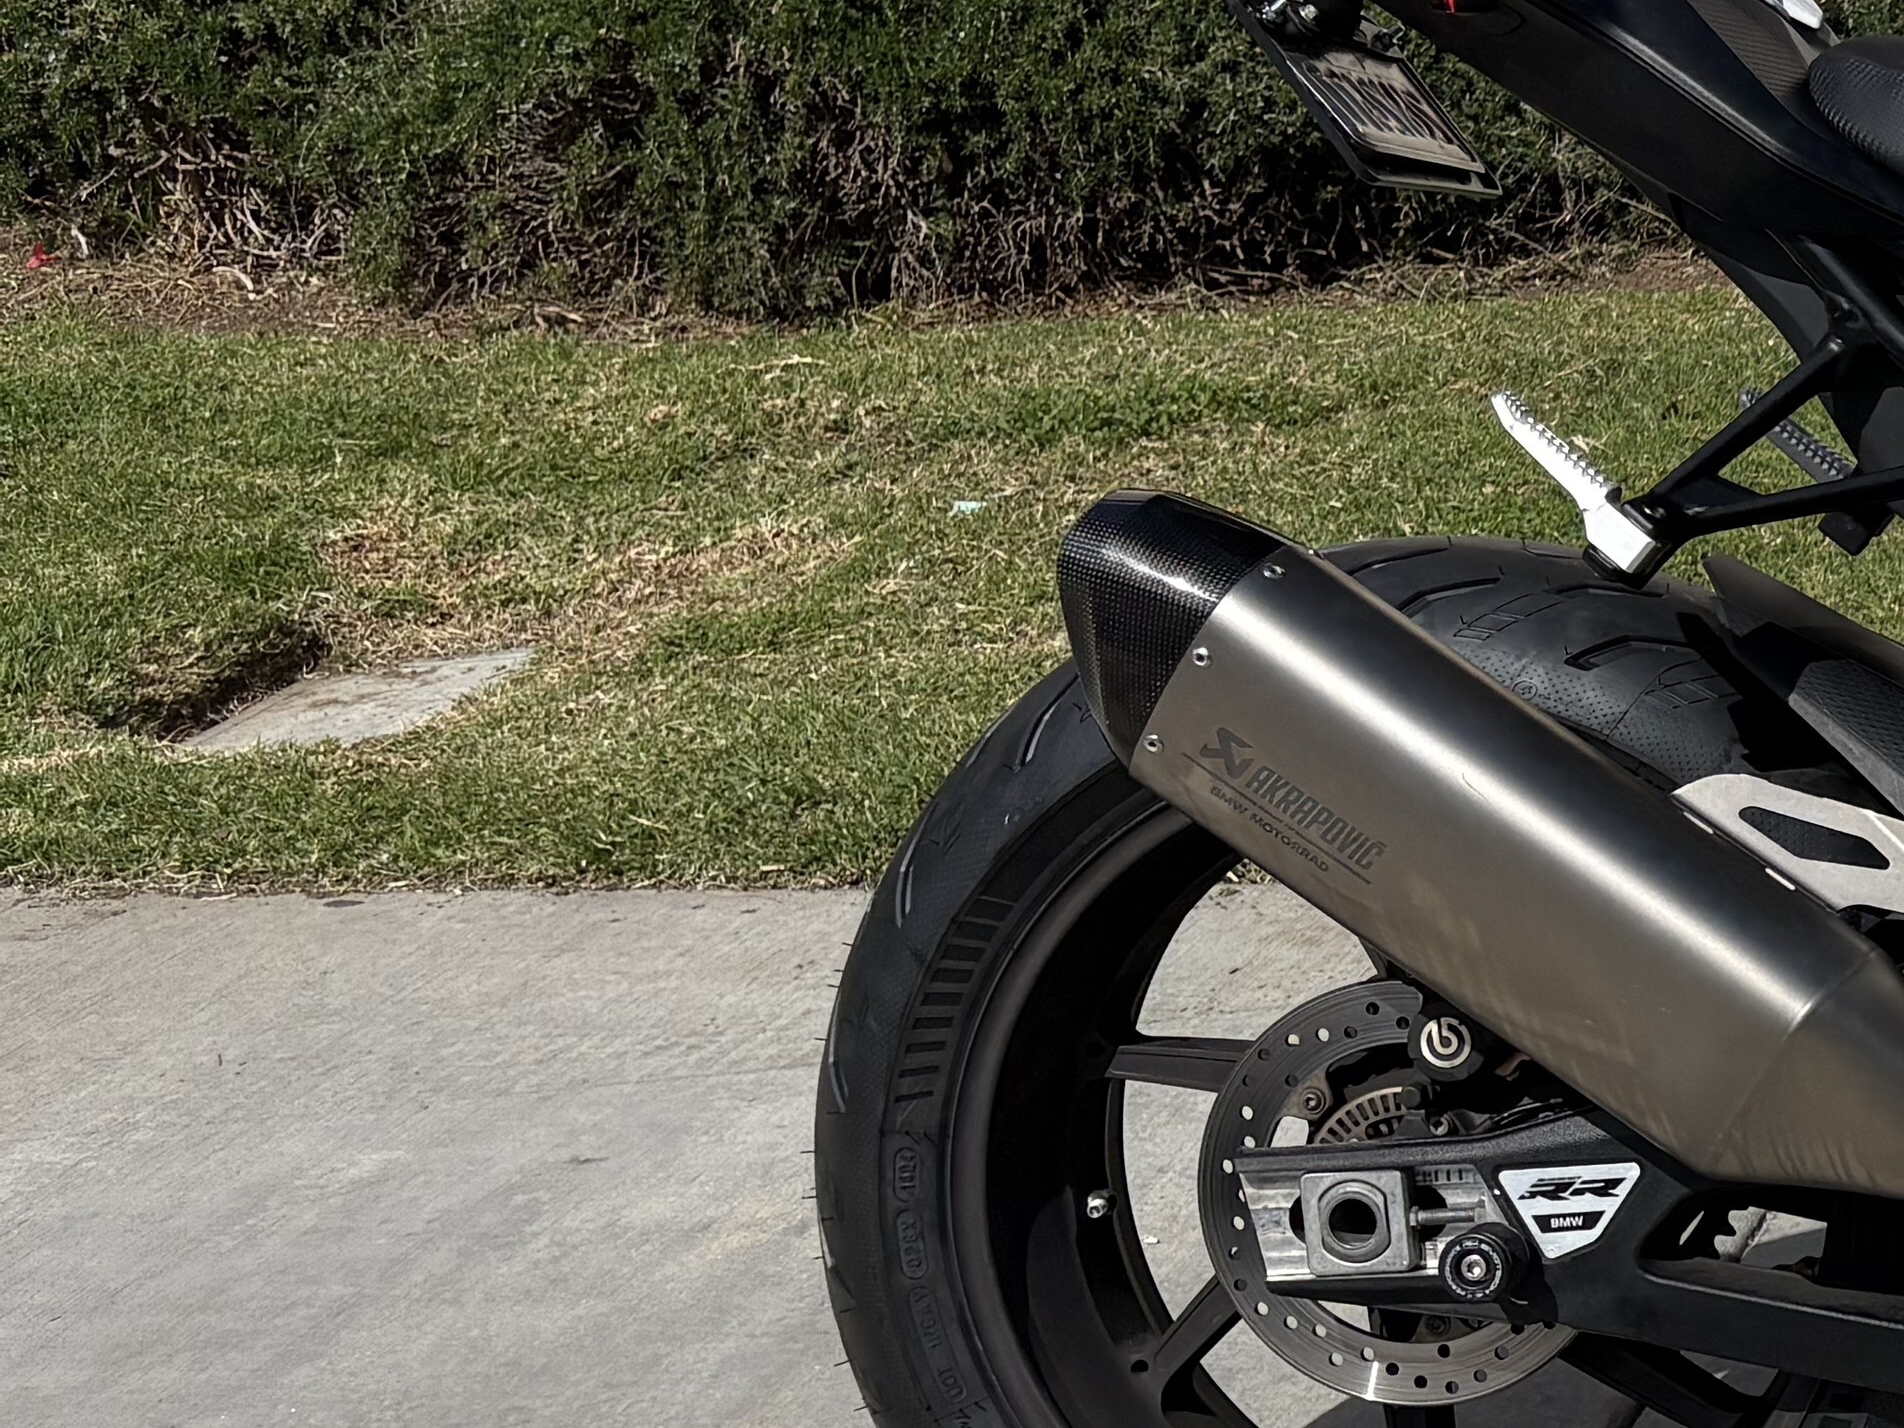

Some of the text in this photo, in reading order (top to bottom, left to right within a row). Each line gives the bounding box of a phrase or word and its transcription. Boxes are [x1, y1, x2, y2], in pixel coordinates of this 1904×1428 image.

[1210, 785, 1248, 814] BMW
[1250, 812, 1330, 872] MOTORRAD
[1517, 1177, 1627, 1202] RR
[1550, 1215, 1584, 1229] BMW
